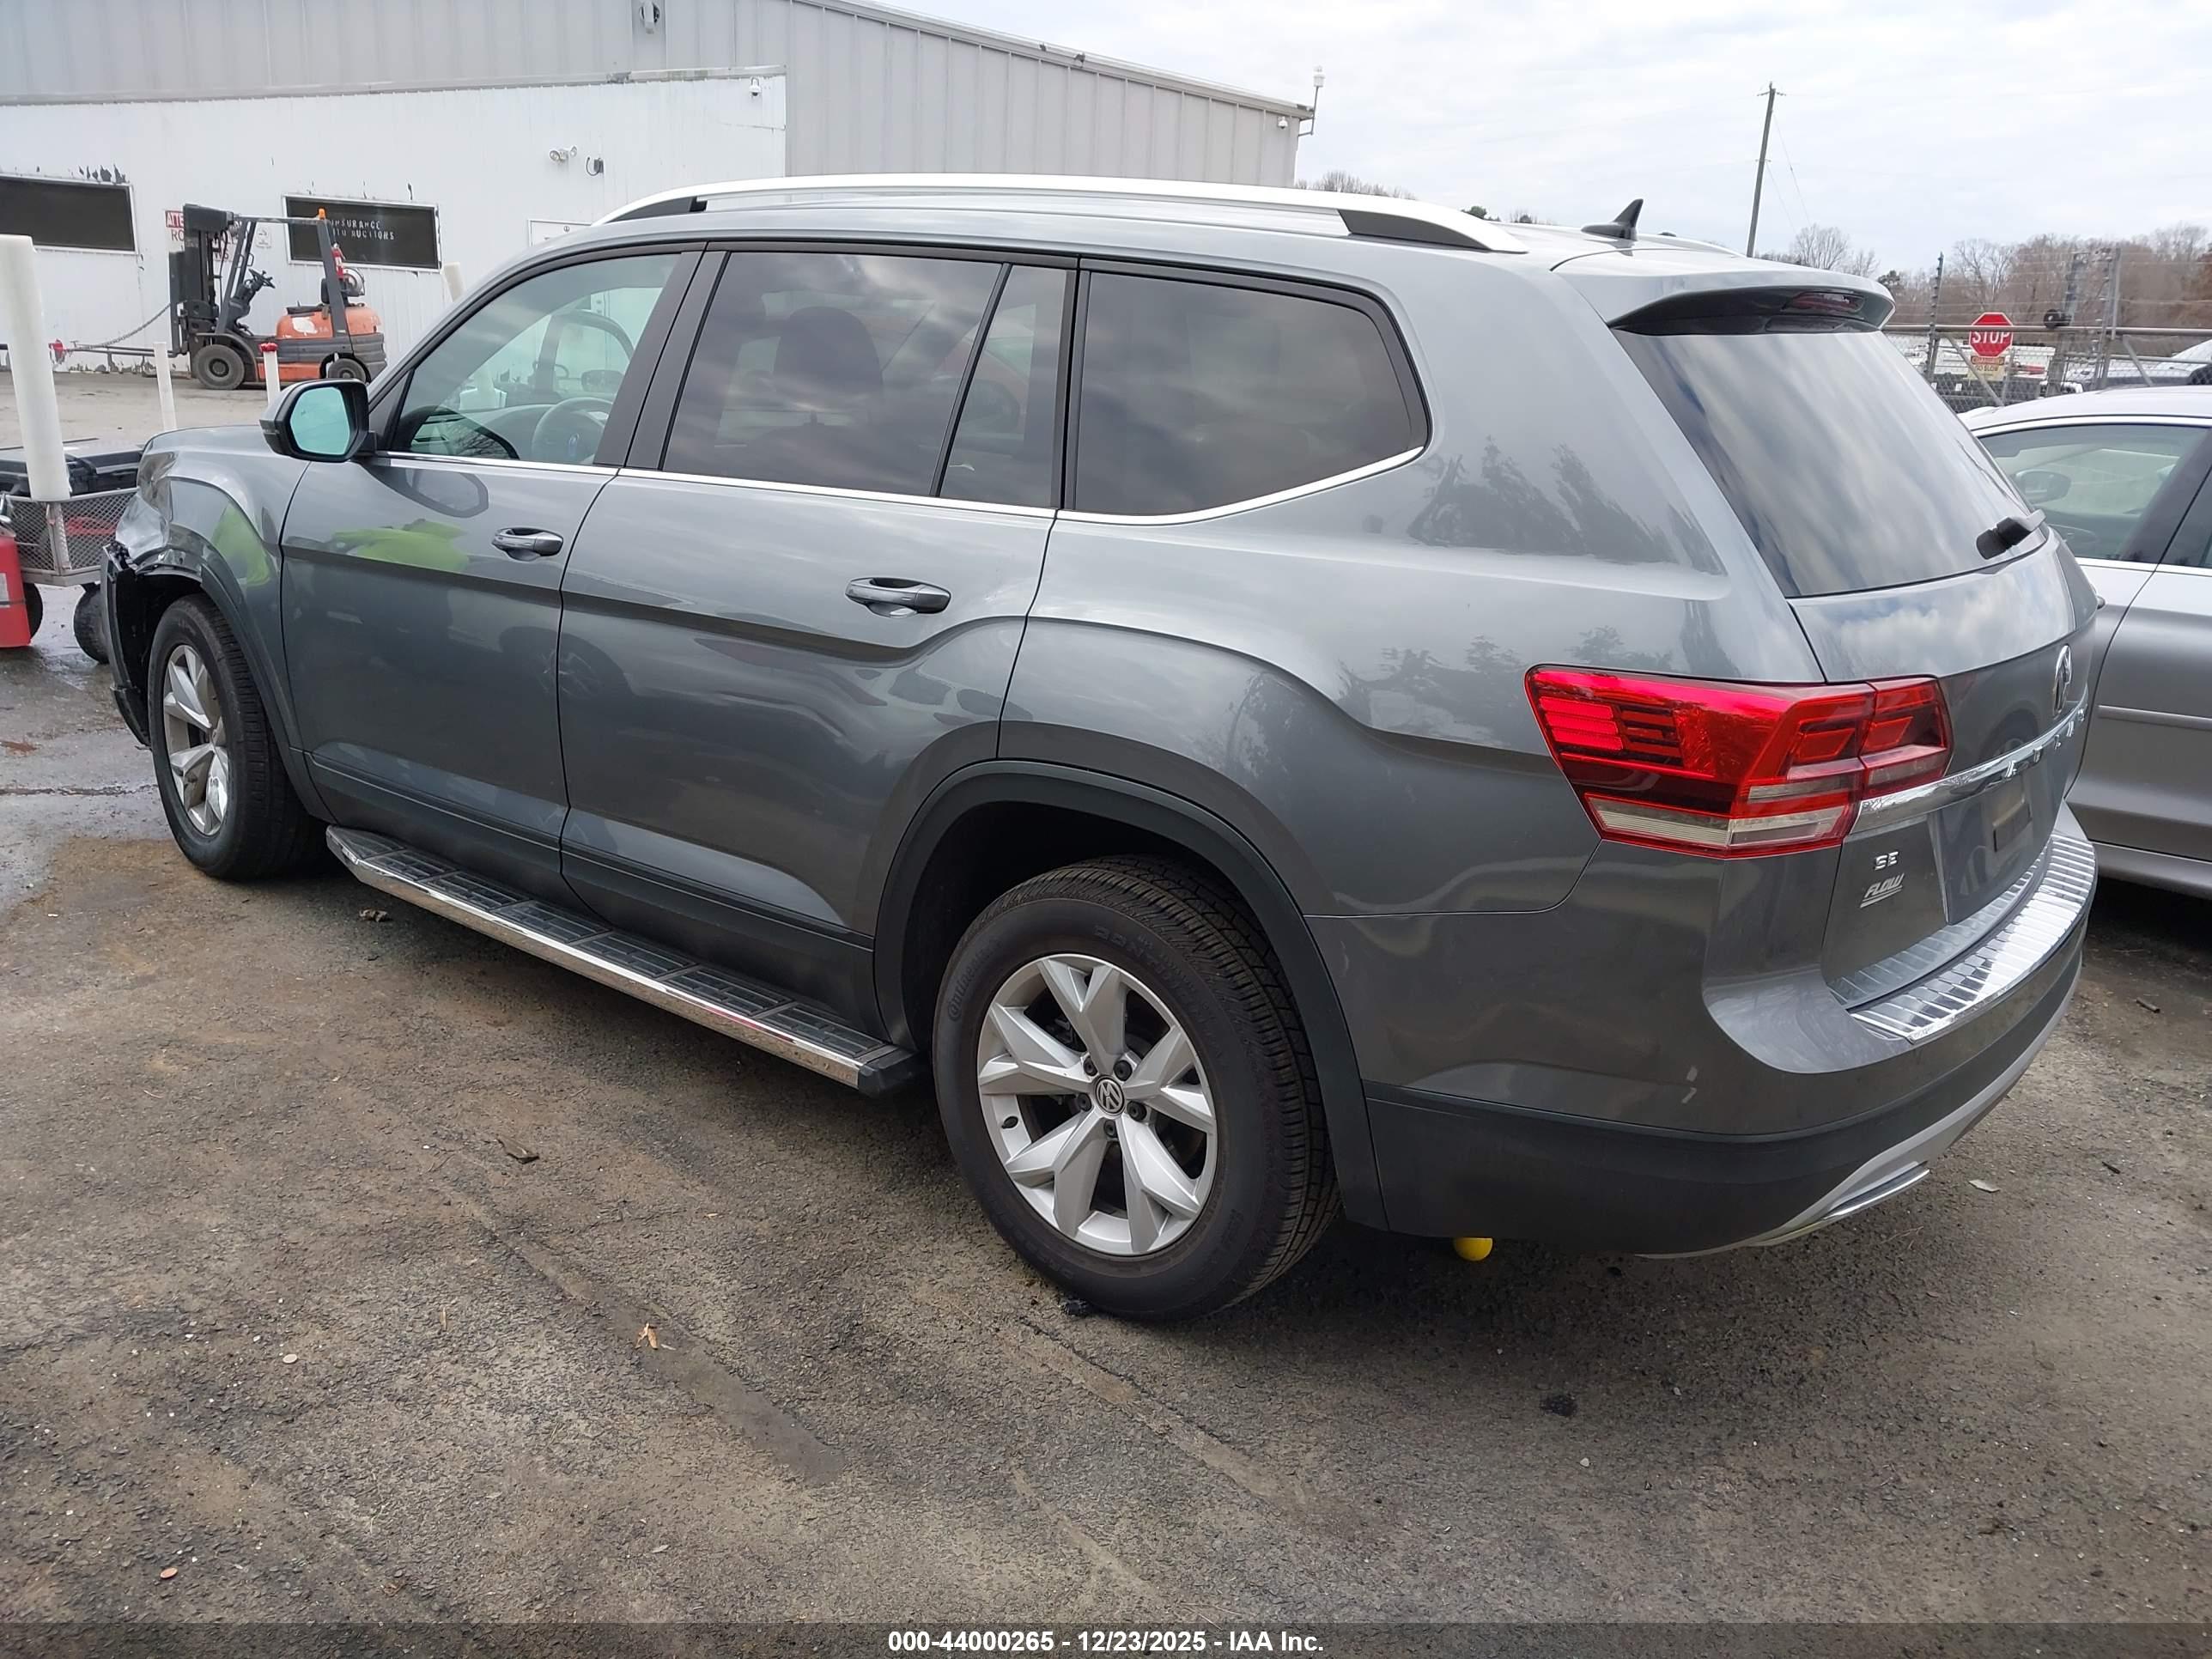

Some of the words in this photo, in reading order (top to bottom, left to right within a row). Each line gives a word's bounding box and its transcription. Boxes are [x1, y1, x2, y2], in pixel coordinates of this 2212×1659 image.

[331, 219, 380, 230] INSURANCE
[351, 229, 395, 240] AUCTIONS
[1972, 331, 2010, 343] STOP
[1875, 851, 1899, 871] SE
[1863, 872, 1905, 899] FLOW
